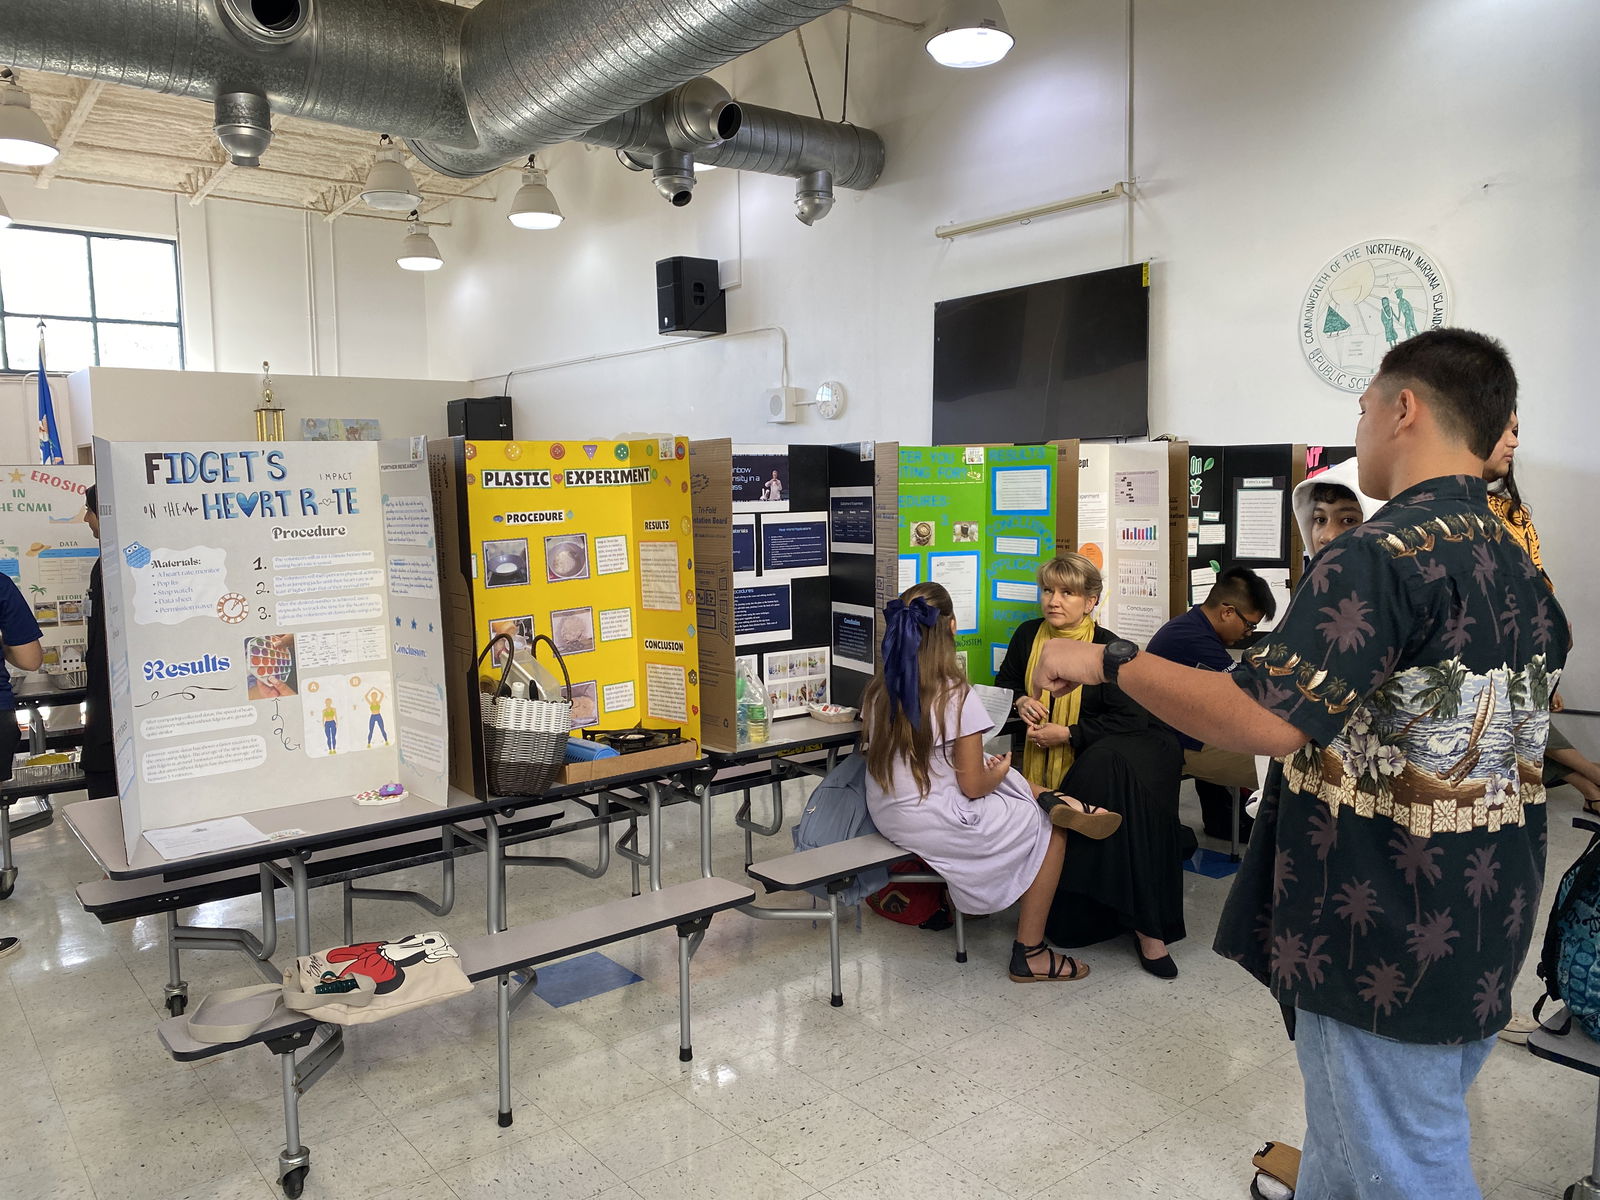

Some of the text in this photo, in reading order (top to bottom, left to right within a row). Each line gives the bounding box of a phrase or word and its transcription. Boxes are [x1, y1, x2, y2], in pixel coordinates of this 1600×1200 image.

[1304, 272, 1331, 345] COMMONWEALTH
[1330, 260, 1342, 273] OF
[1343, 248, 1361, 264] THE
[1365, 243, 1415, 262] NORTHERN
[1414, 256, 1441, 291] MARIANA
[1313, 355, 1347, 386] PUBLIC
[144, 449, 287, 485] FIDGET'S
[484, 467, 650, 486] PLASTIC EXPERIMENT
[12, 489, 26, 498] IN
[17, 503, 52, 512] CNMI
[163, 501, 182, 517] THE
[506, 511, 564, 523] PROCEDURE
[644, 520, 670, 530] RESULTS
[272, 524, 346, 539] Procedure
[151, 557, 201, 569] Materials:
[1127, 605, 1153, 613] Conclusion
[64, 637, 85, 645] AFTER
[644, 640, 684, 651] CONCLUSION
[143, 654, 231, 681] Results
